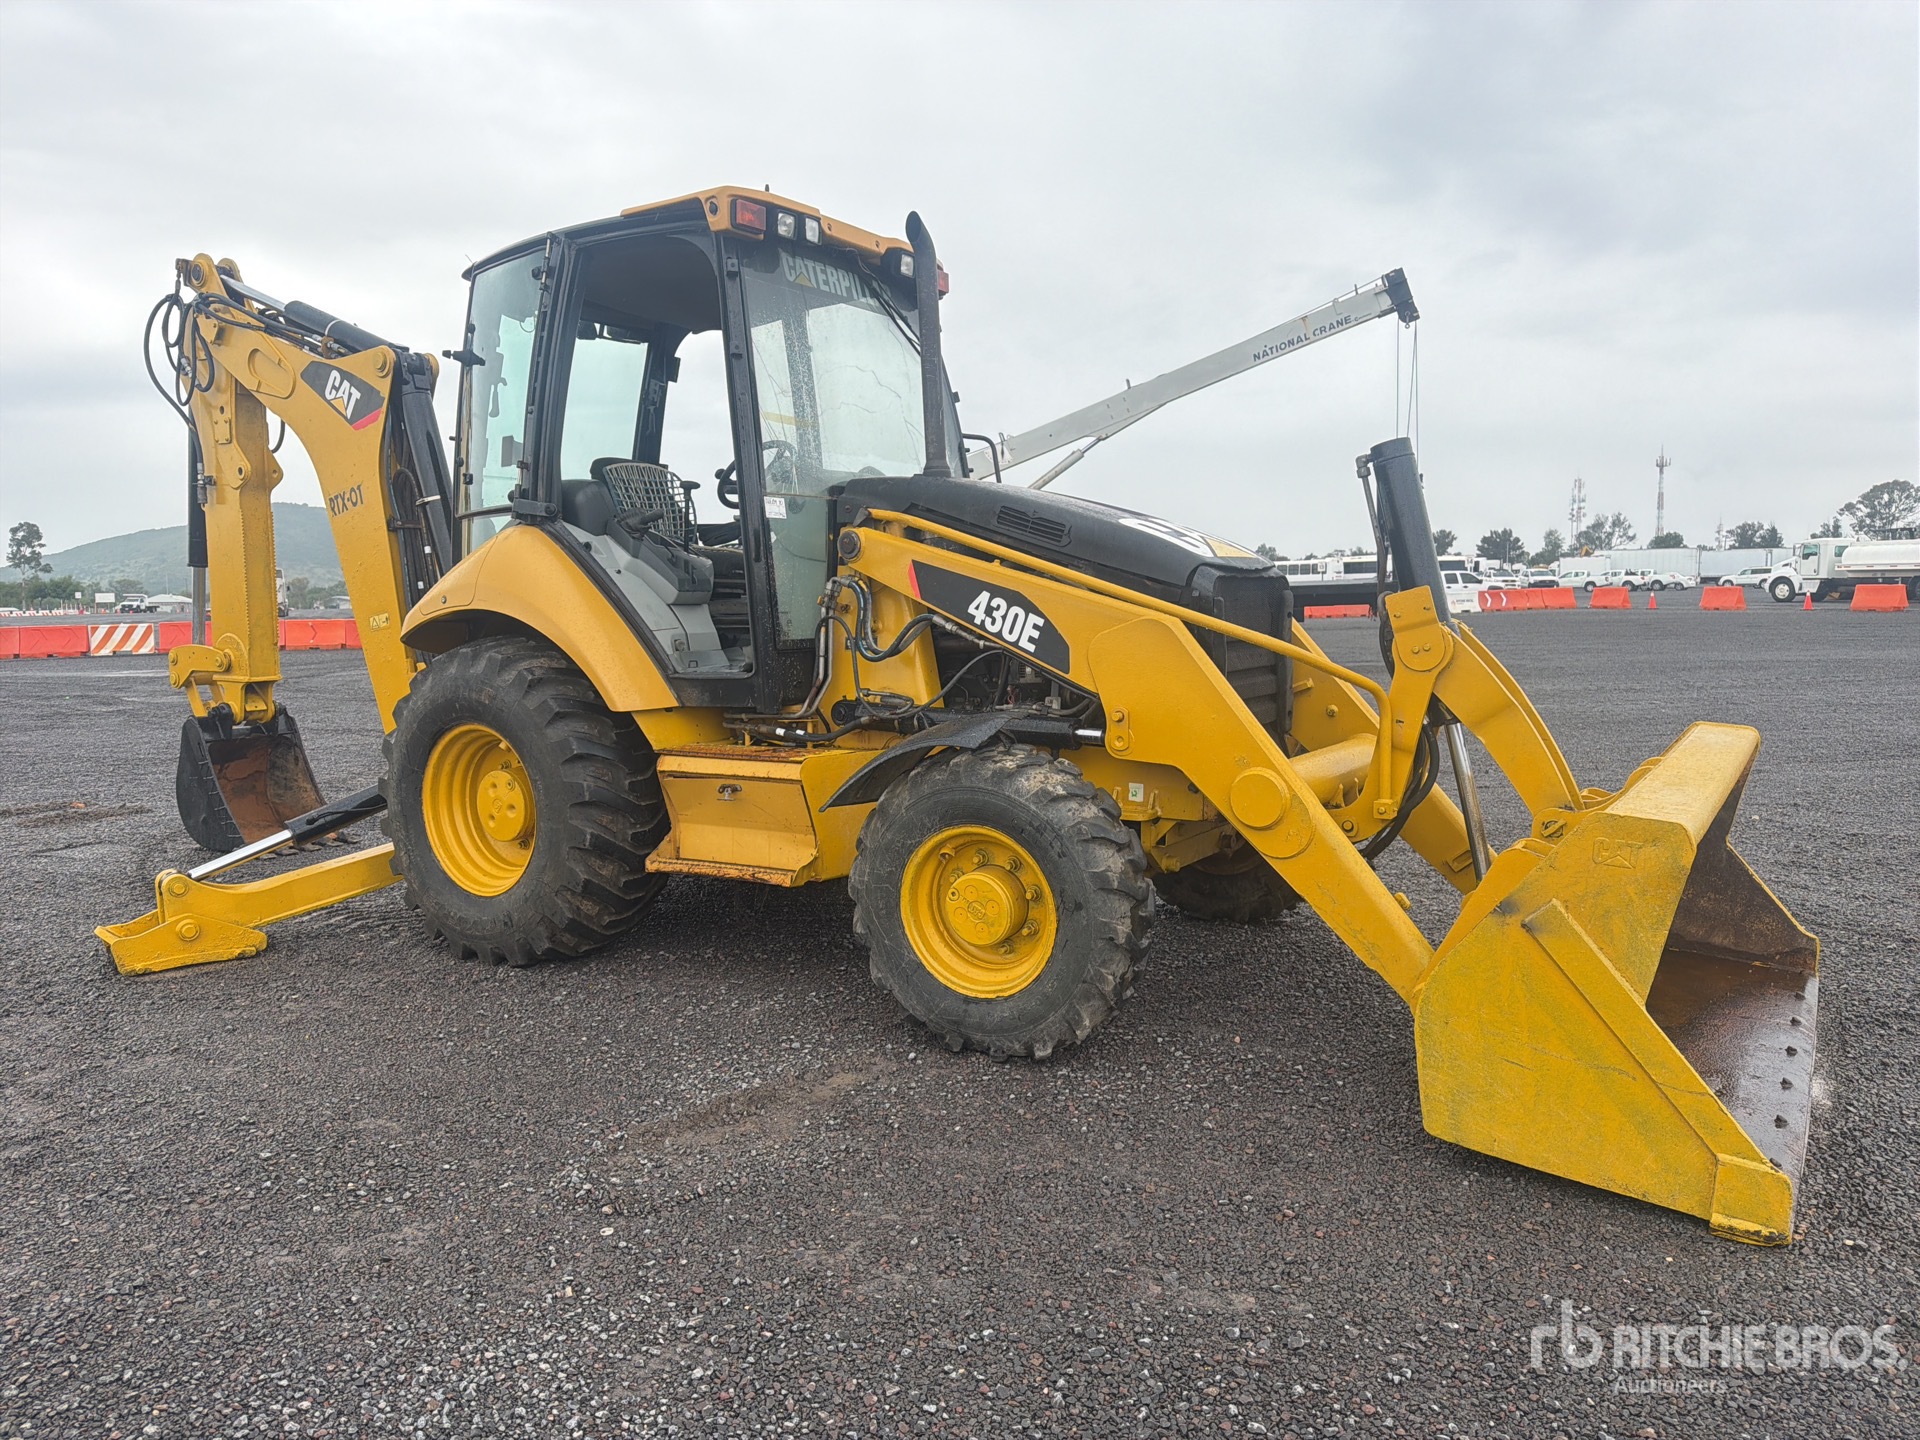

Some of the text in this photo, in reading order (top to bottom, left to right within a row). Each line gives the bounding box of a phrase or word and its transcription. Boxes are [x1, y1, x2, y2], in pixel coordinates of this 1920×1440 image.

[1252, 314, 1353, 362] NATIONAL CRANE
[324, 369, 362, 420] CAT
[967, 589, 1046, 654] 430E
